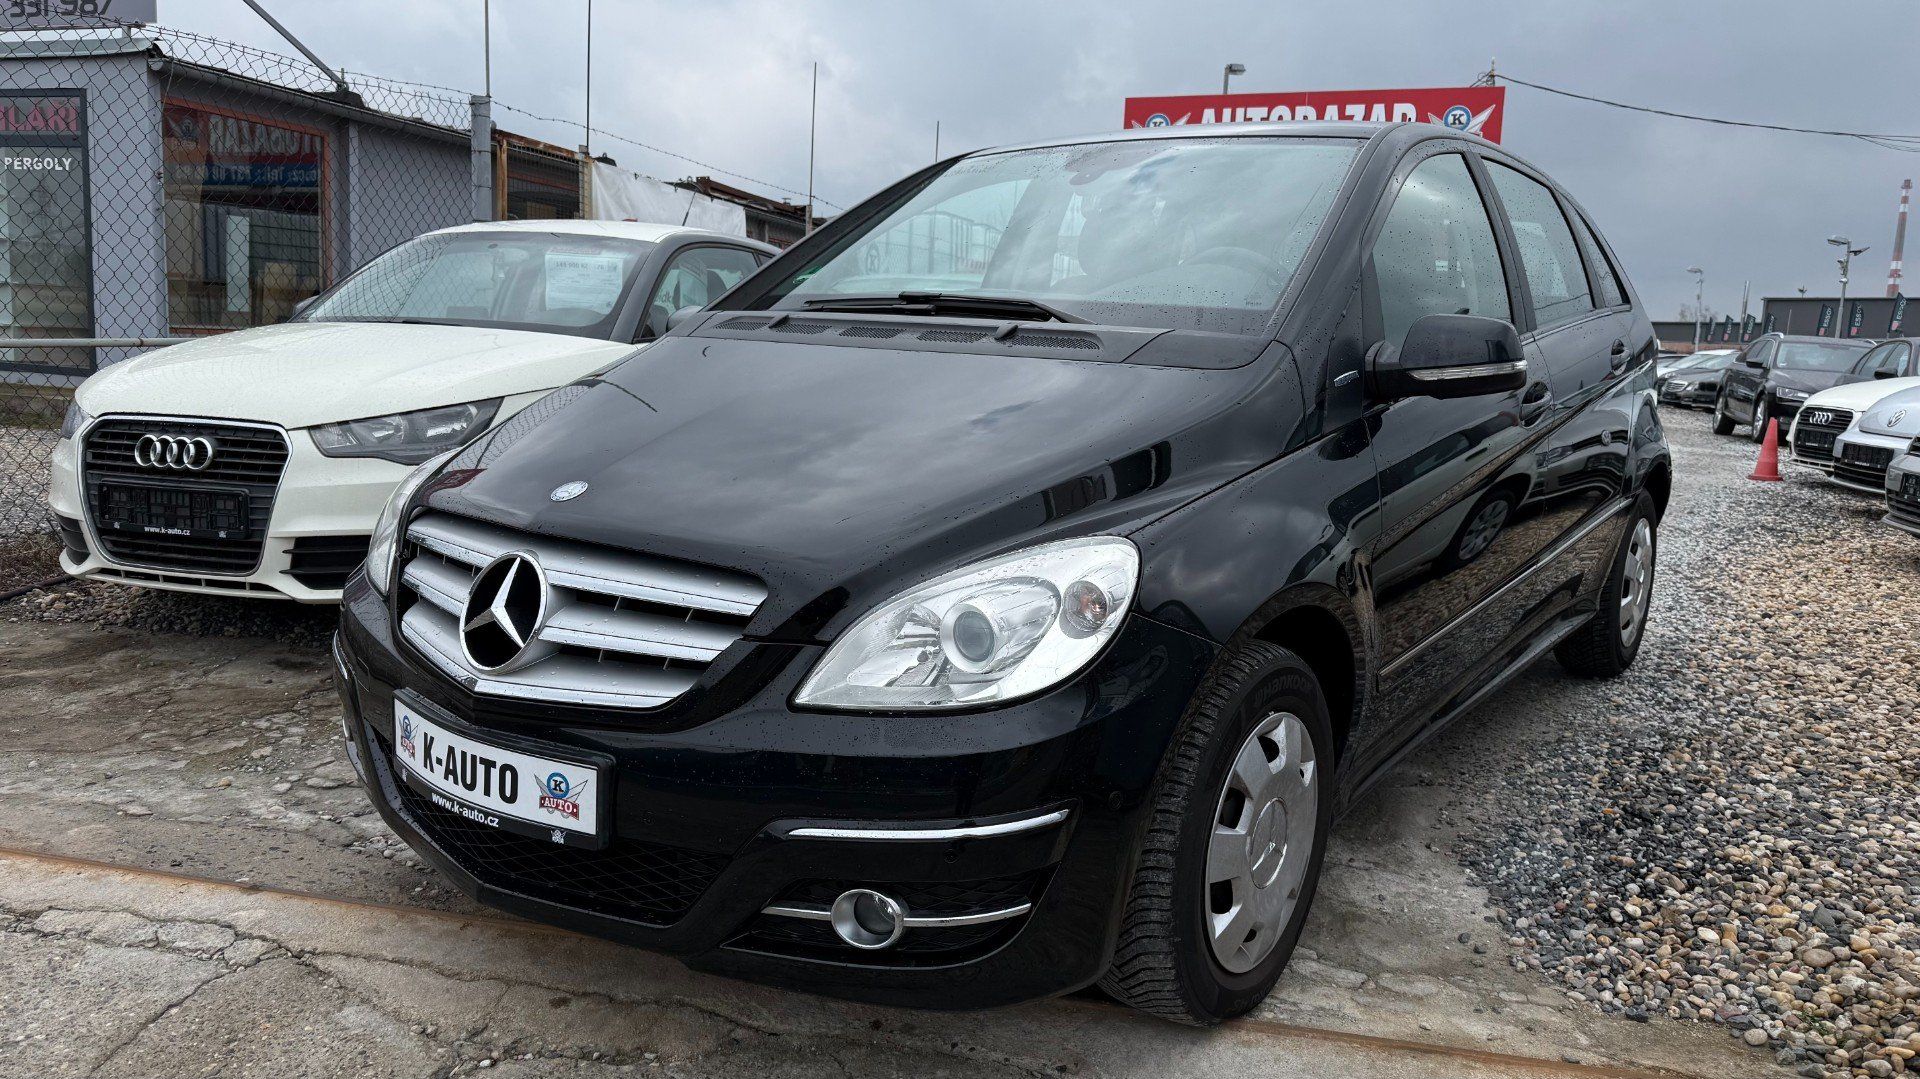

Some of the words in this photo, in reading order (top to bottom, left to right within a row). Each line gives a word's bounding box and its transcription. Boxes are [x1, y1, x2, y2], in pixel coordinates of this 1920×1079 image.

[1450, 113, 1465, 126] K
[4, 157, 73, 171] PERGOLY
[144, 526, 191, 536] www.k-auto.cz
[423, 731, 519, 805] K-AUTO
[552, 779, 565, 793] K
[431, 792, 499, 829] www.k-auto.cz
